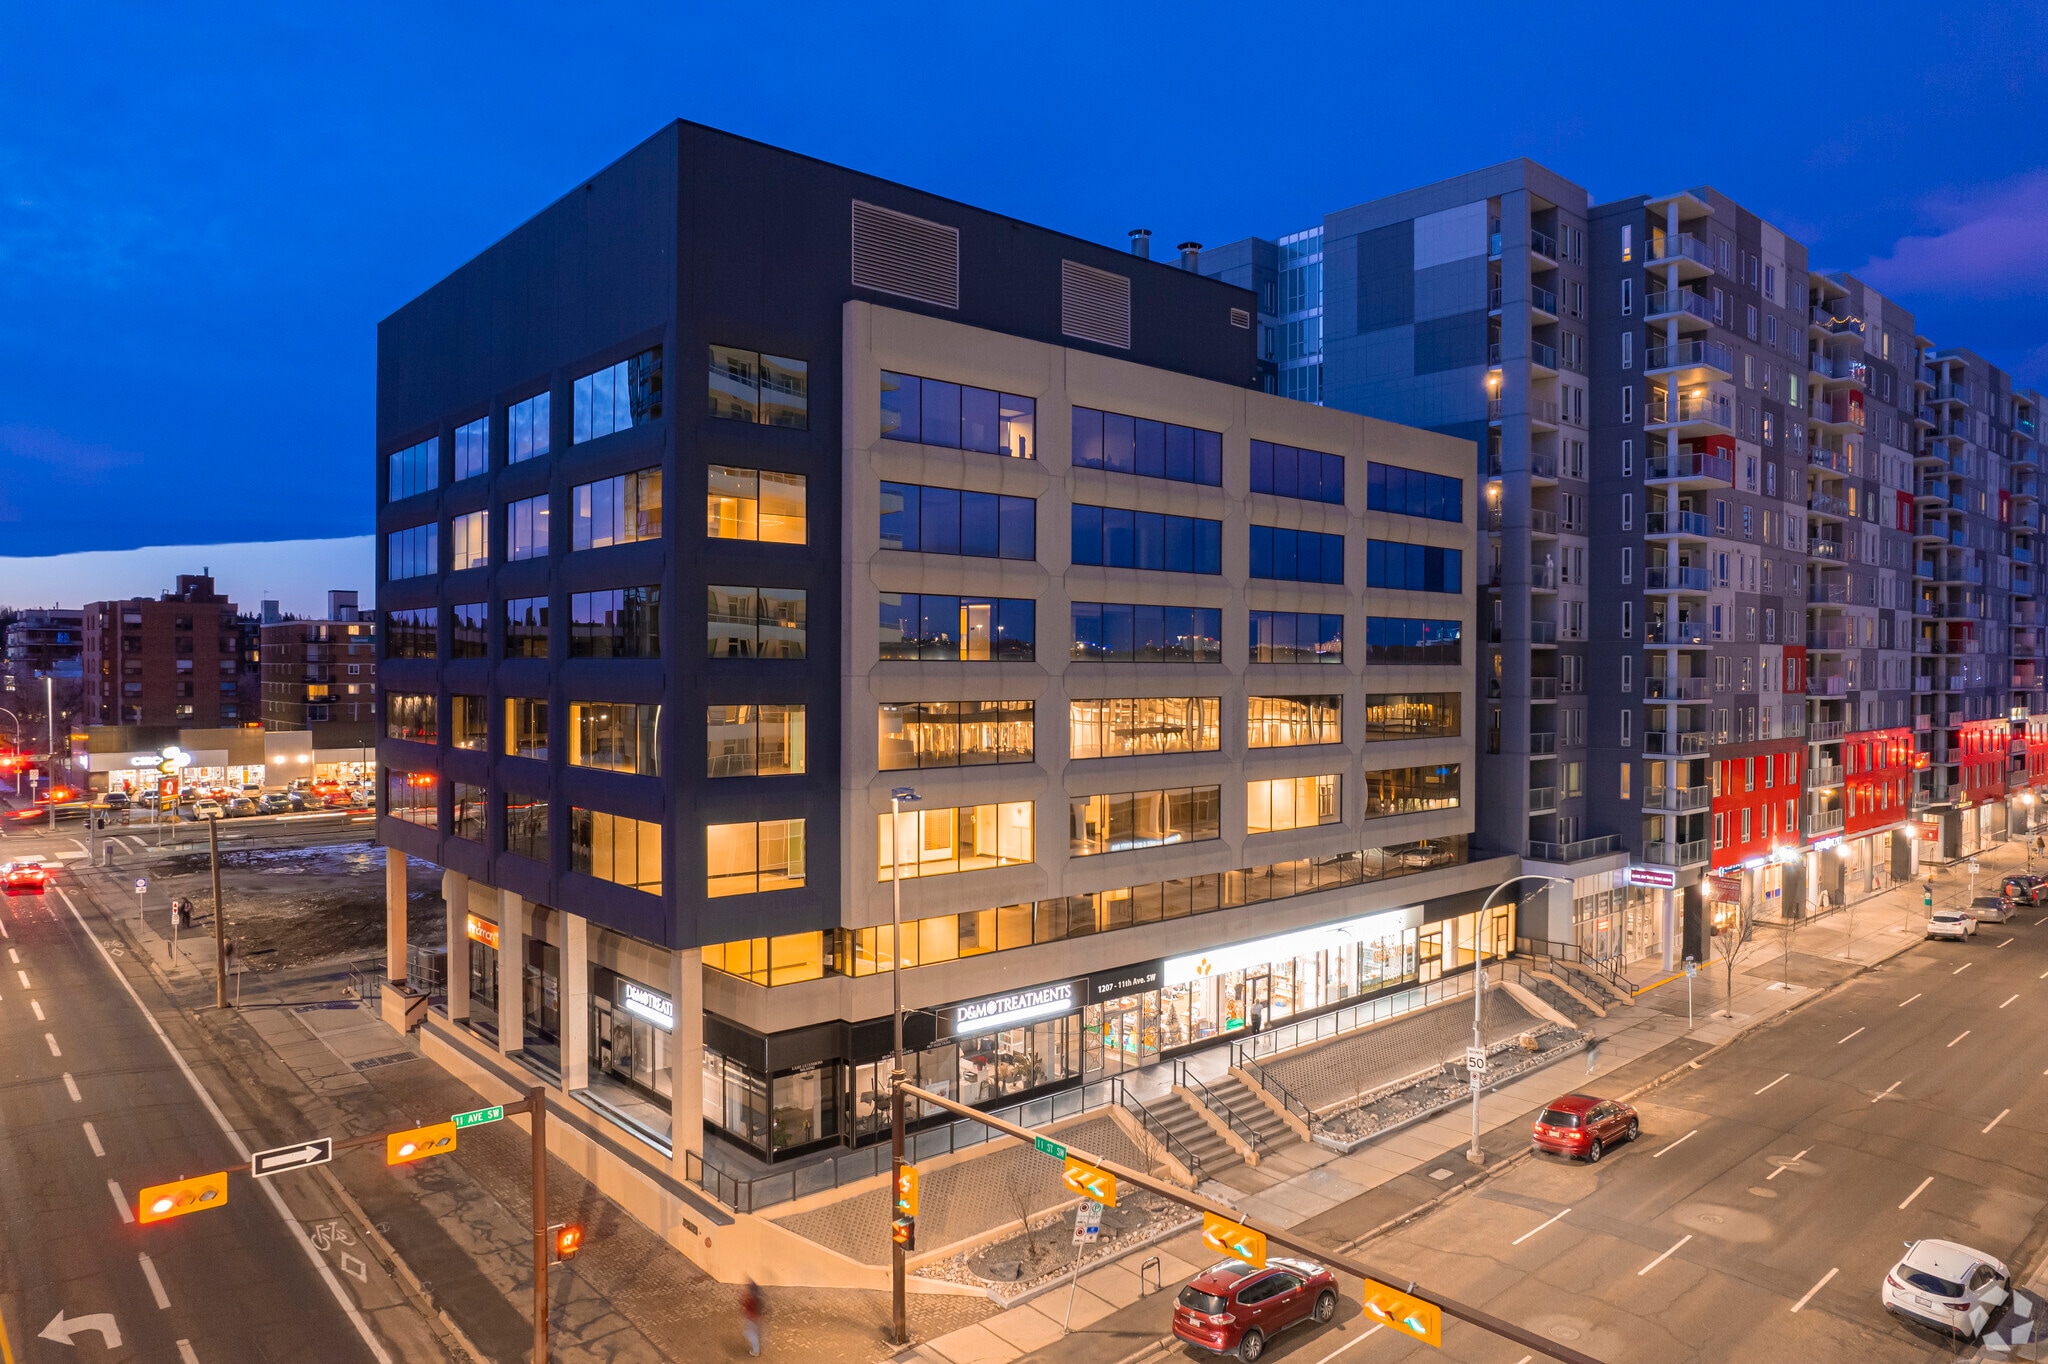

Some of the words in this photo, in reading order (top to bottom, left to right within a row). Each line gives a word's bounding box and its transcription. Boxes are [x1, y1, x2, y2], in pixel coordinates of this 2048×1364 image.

[1097, 984, 1113, 994] 1207
[1118, 979, 1132, 990] 11th
[1133, 977, 1146, 986] Ave.
[1146, 973, 1156, 983] SW
[957, 1003, 988, 1022] D&M
[996, 985, 1072, 1013] TREATMENTS
[1469, 1057, 1484, 1069] 50
[456, 1117, 463, 1126] 11
[468, 1112, 483, 1123] AVE
[487, 1109, 500, 1119] SW
[1037, 1139, 1044, 1149] 11
[1047, 1143, 1053, 1153] ST
[1056, 1147, 1065, 1157] SW
